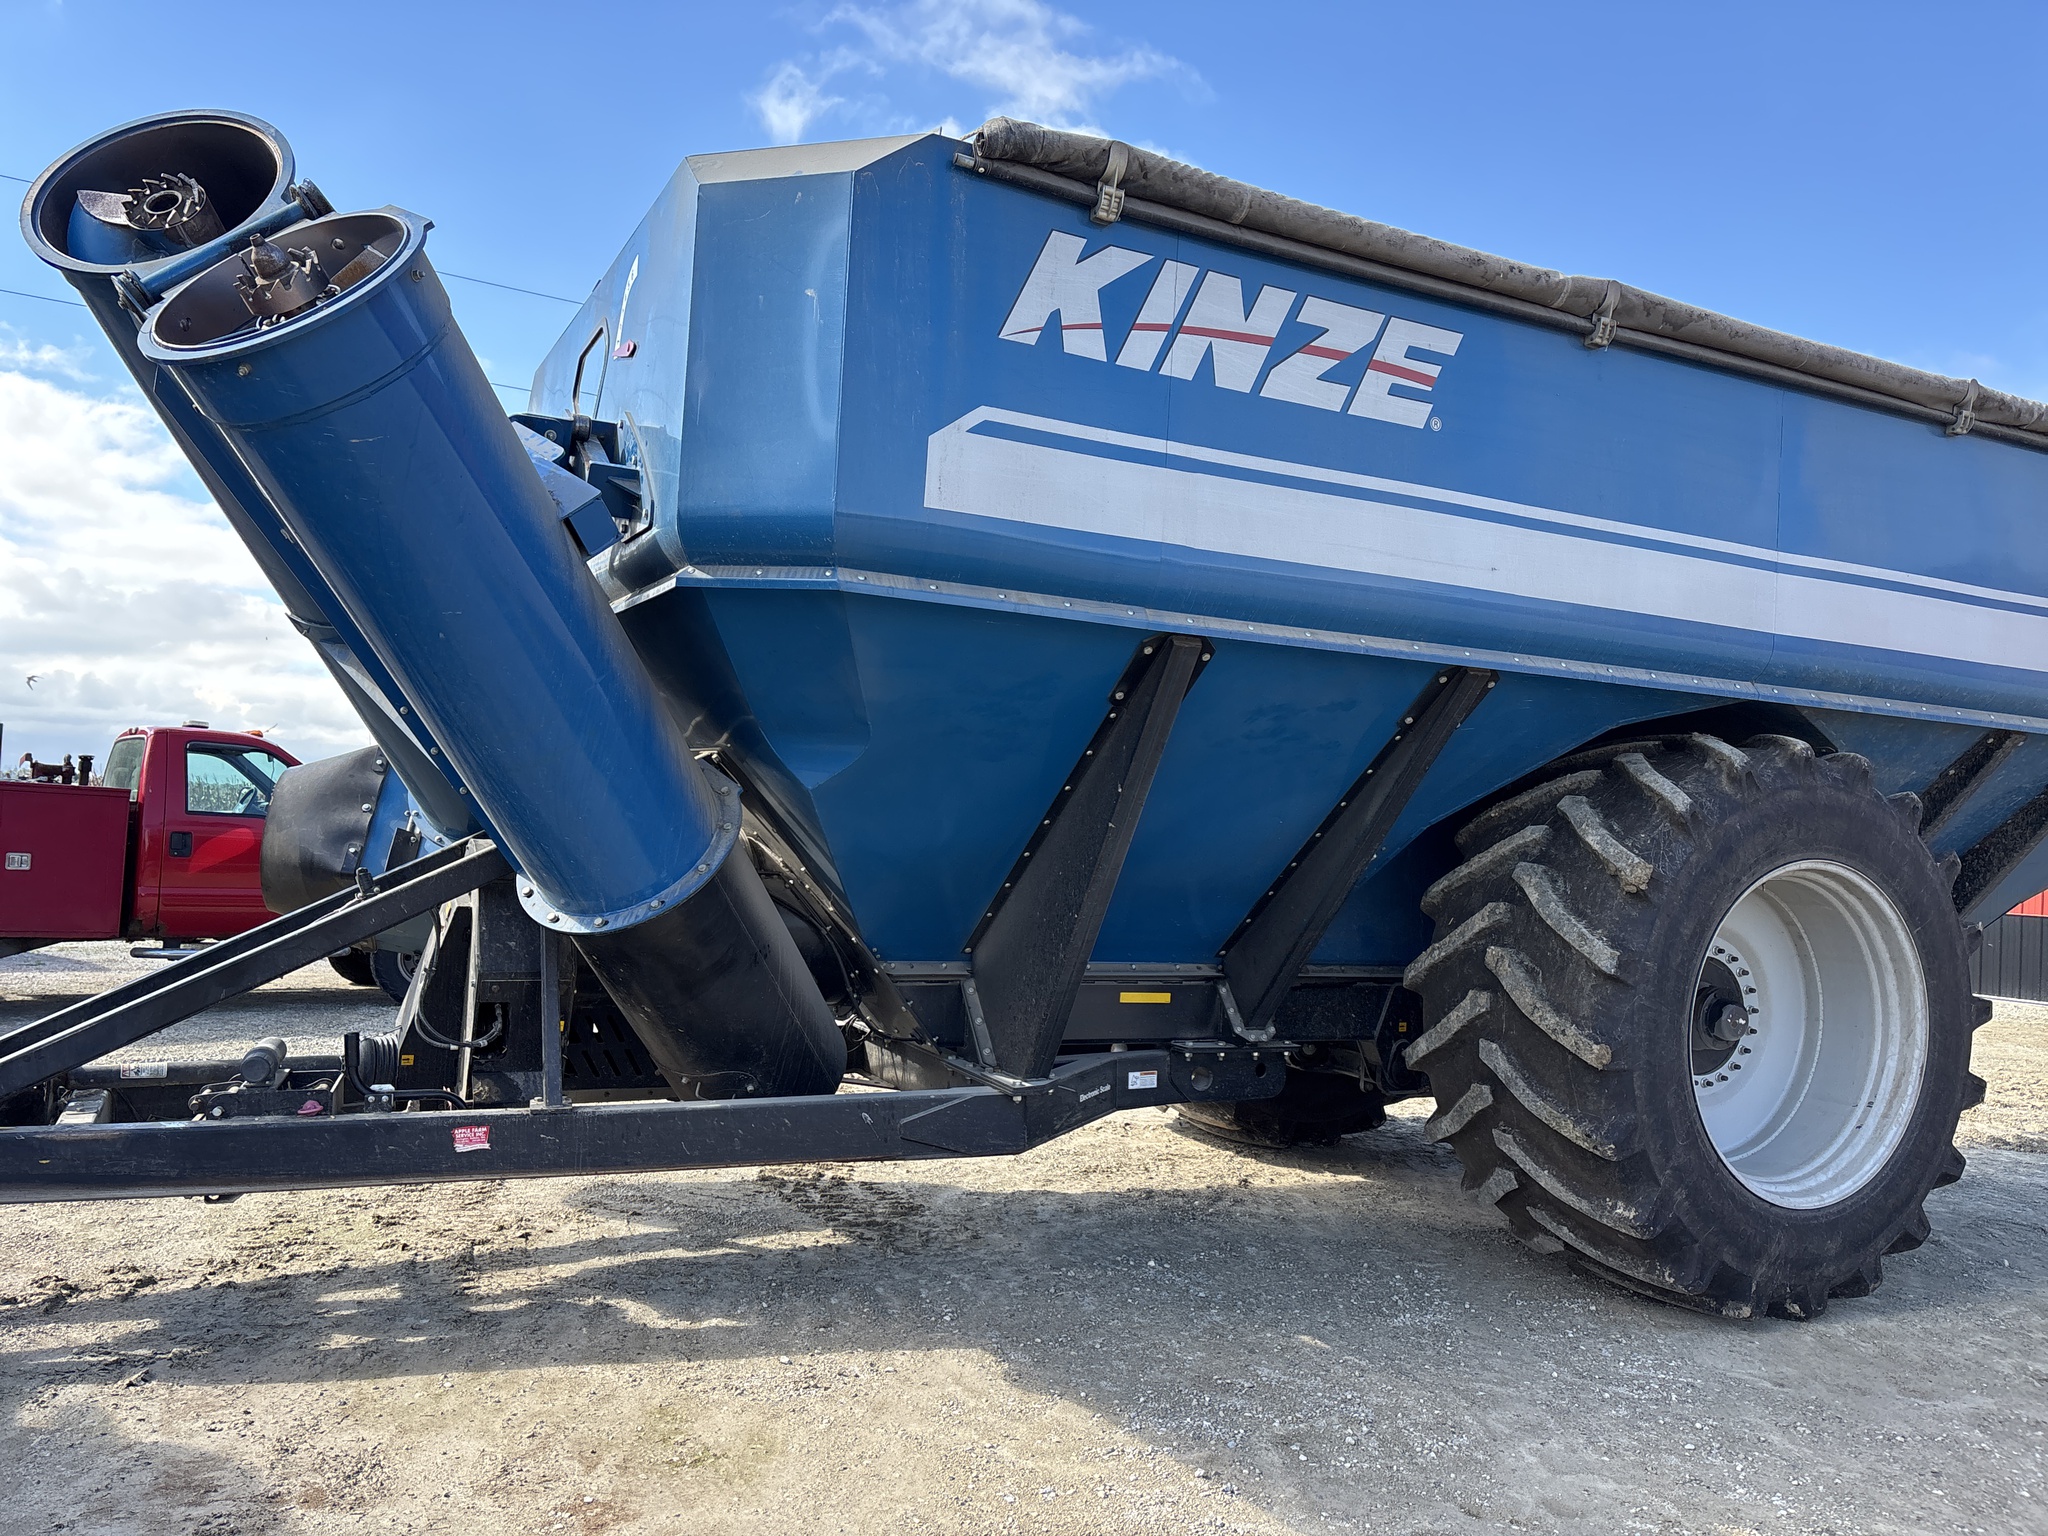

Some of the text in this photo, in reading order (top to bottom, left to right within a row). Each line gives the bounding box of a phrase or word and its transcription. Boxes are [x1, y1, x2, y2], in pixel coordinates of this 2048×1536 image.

[998, 229, 1464, 429] KINZE
[1079, 1083, 1111, 1103] Electronic Scale
